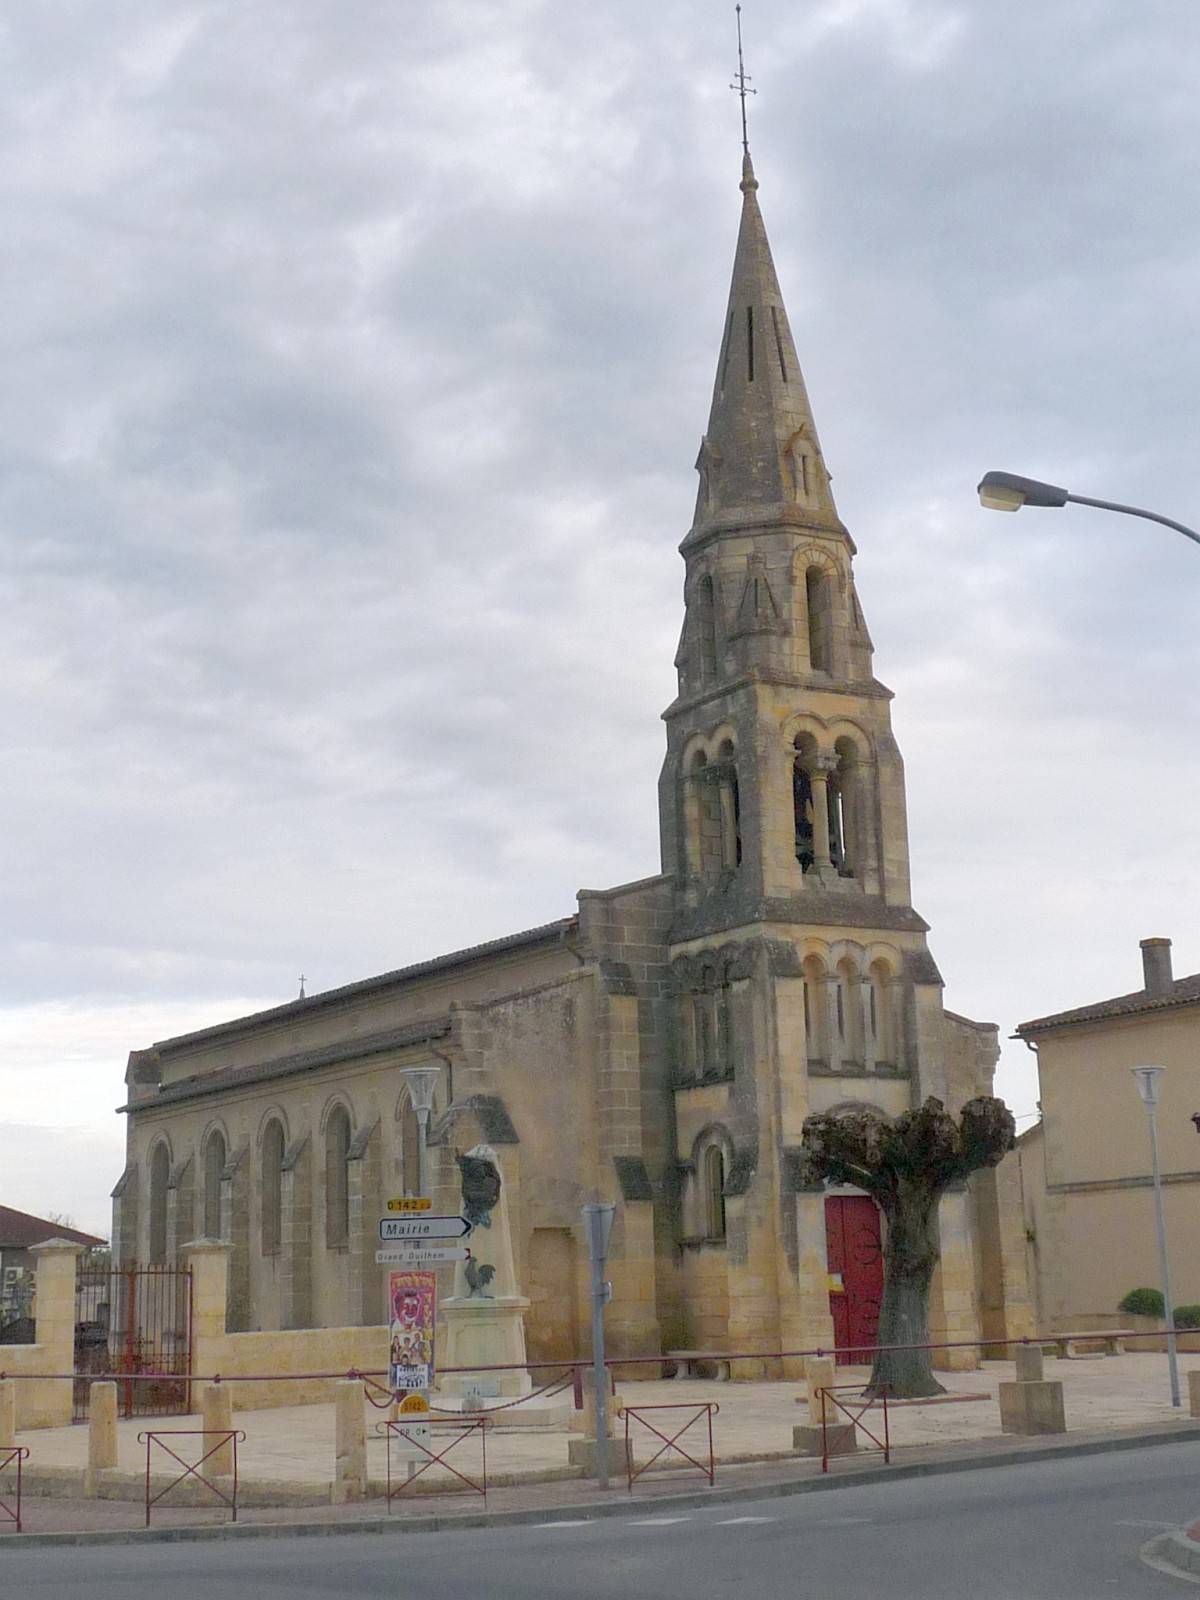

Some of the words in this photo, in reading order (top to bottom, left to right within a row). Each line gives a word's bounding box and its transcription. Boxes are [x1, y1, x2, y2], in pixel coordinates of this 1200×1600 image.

[386, 1223, 430, 1235] Mairie
[377, 1253, 404, 1261] Grand
[408, 1250, 445, 1260] Guilhem
